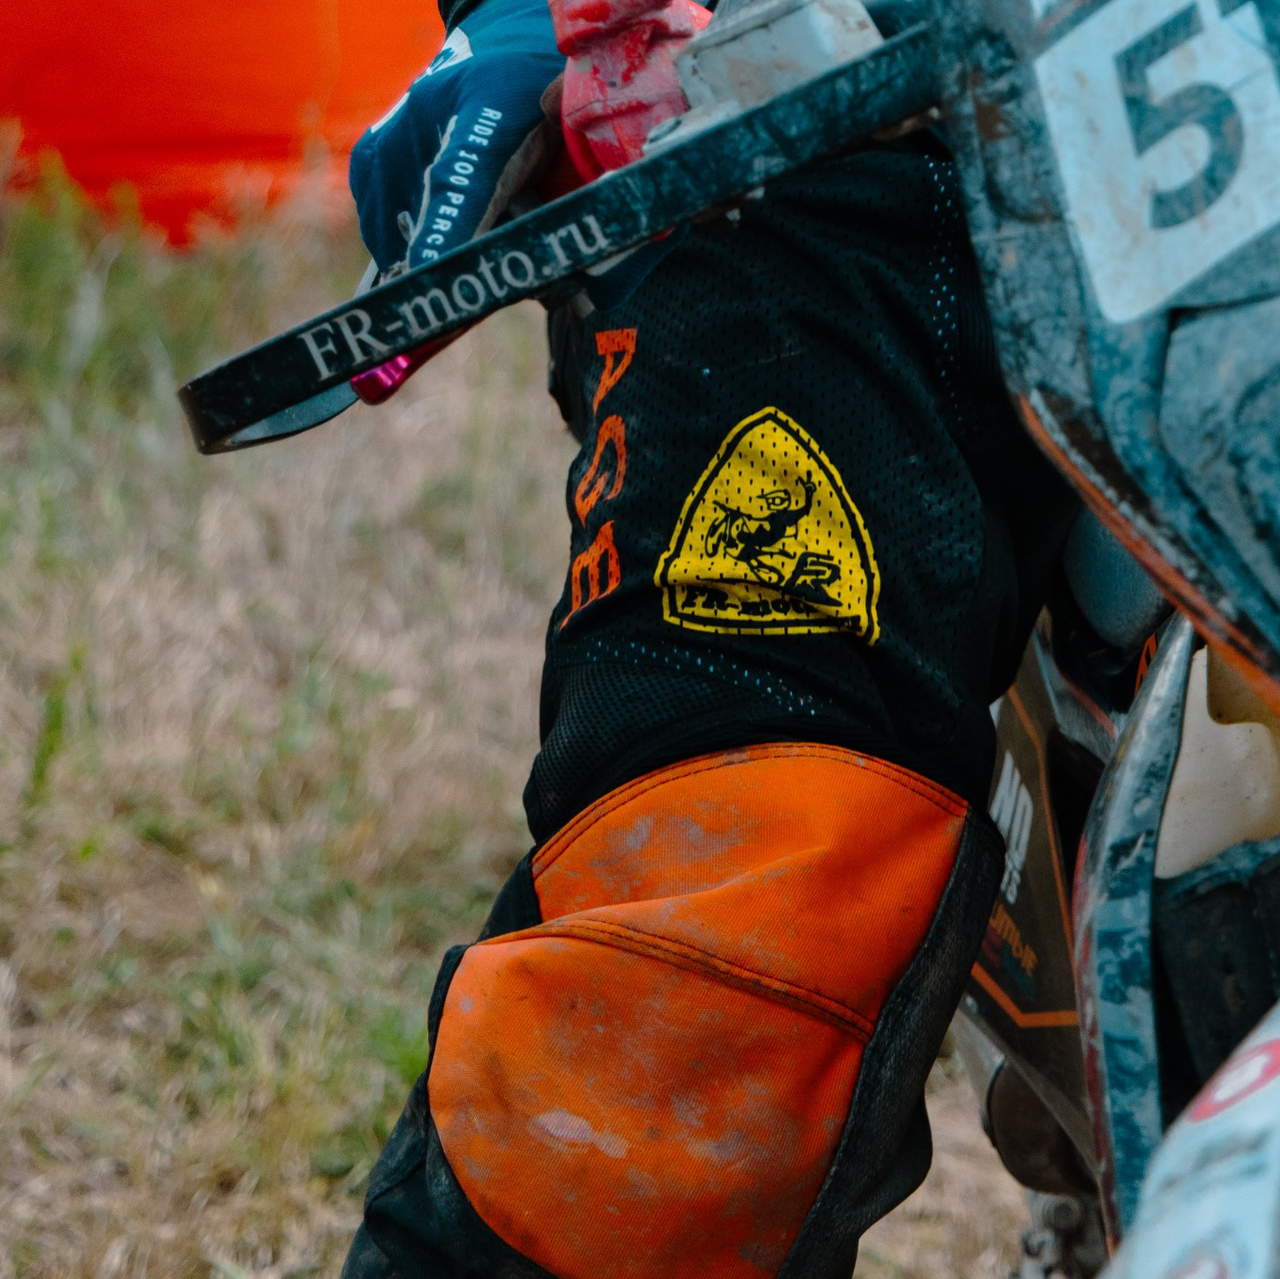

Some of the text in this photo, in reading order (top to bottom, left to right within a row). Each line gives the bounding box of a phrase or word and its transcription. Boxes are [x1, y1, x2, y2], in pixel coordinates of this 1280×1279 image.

[421, 106, 503, 261] RIDE 100 PERCE
[298, 213, 611, 380] FR-moto.ru
